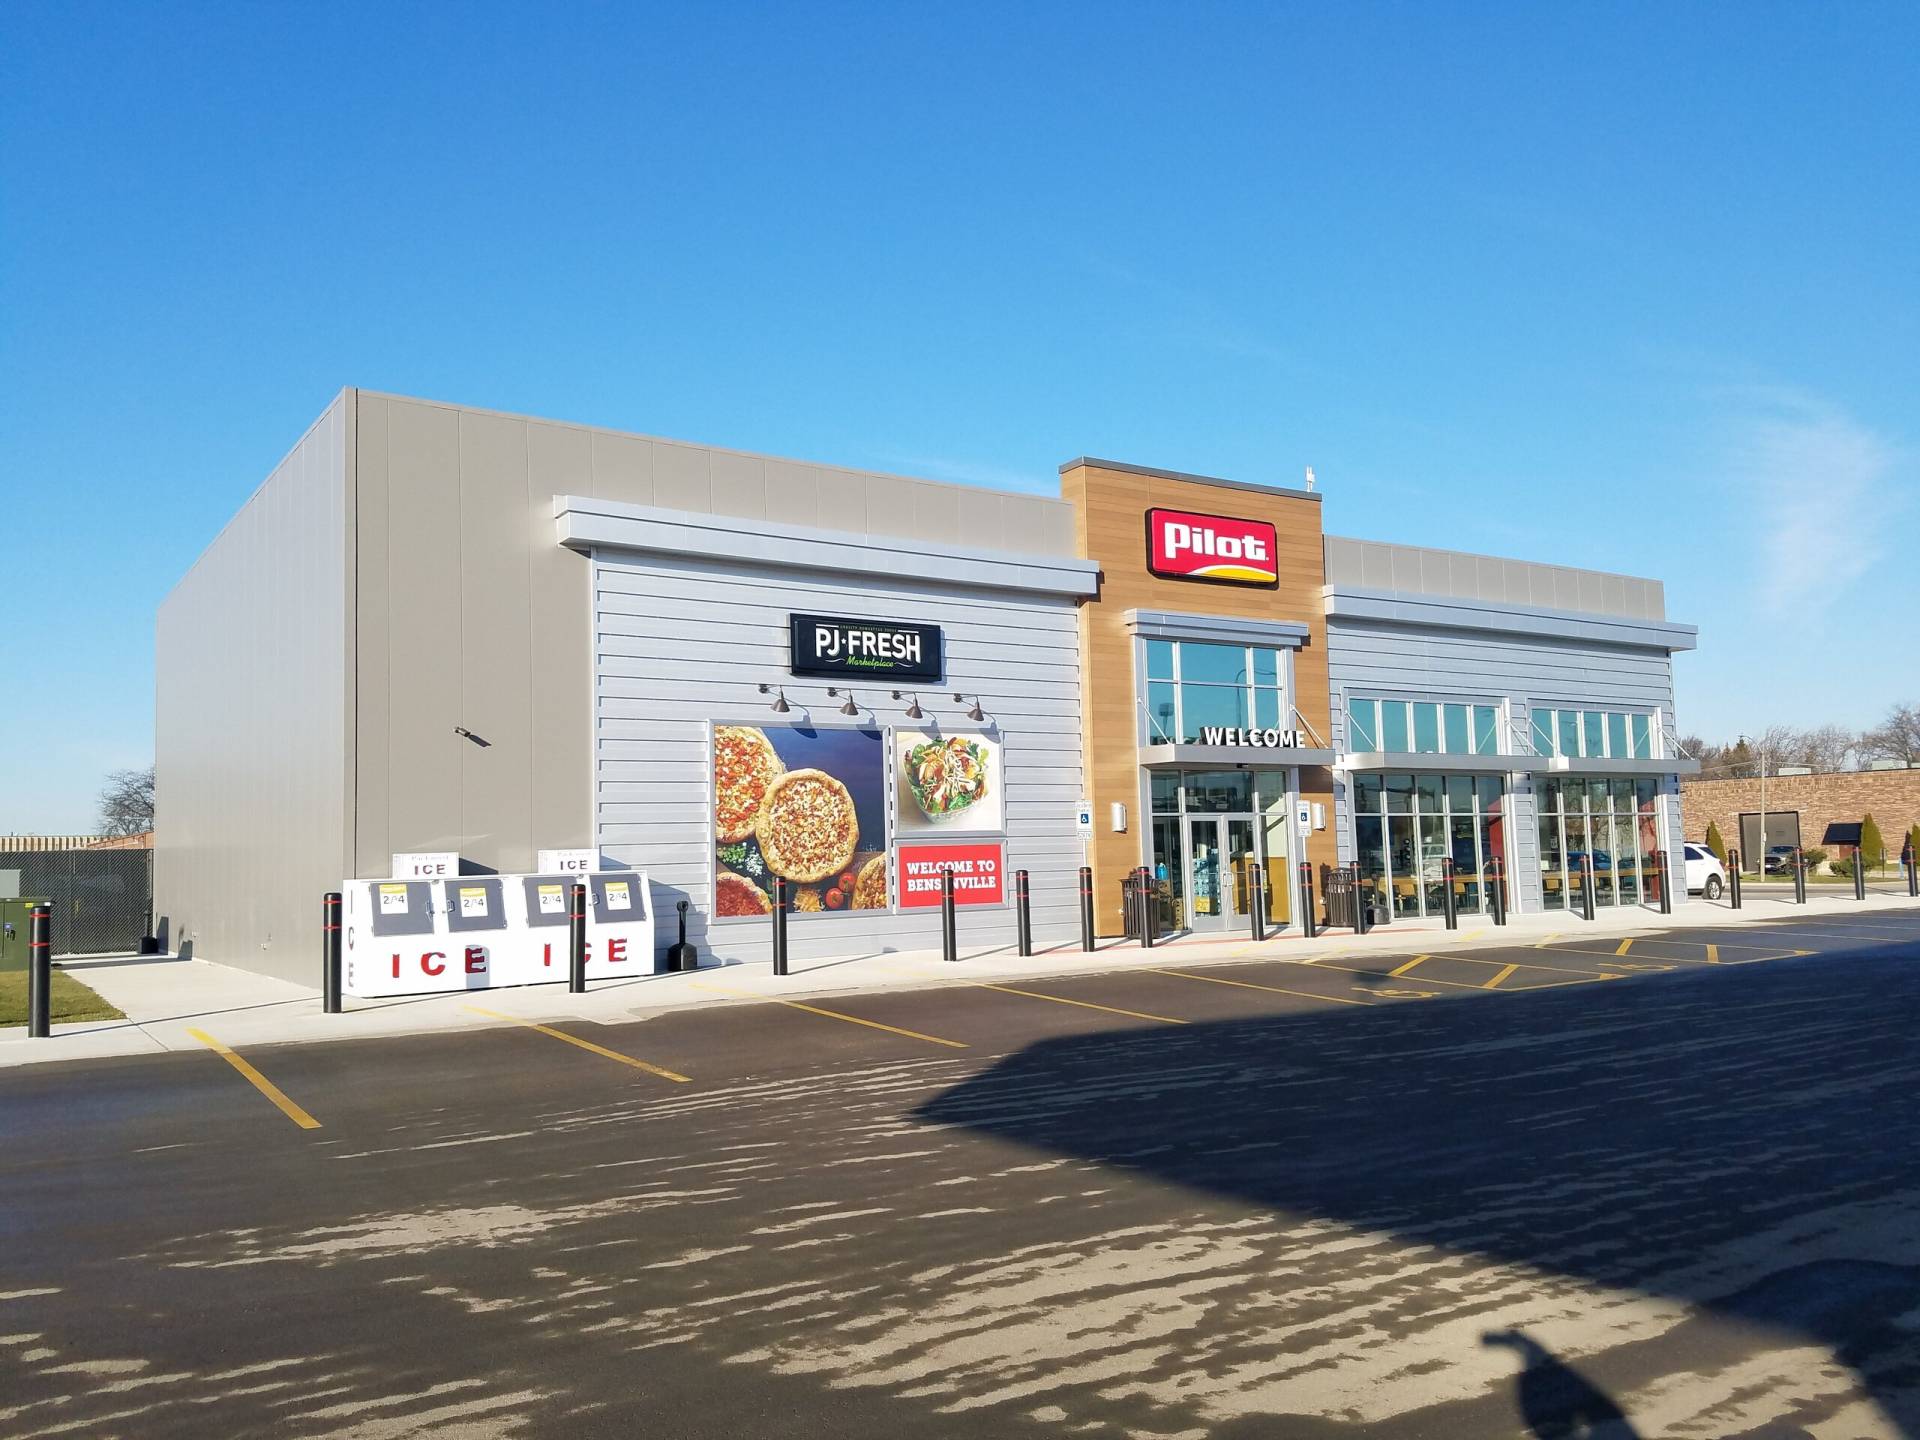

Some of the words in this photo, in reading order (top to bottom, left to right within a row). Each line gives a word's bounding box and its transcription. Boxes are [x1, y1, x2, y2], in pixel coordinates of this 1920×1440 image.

[1164, 522, 1267, 560] Pilot
[847, 630, 921, 663] FRESH
[846, 655, 894, 669] Marketplace
[1202, 726, 1306, 749] WELCOME
[414, 864, 446, 875] ICE
[560, 860, 588, 871] ICE
[907, 861, 974, 875] WELCOME
[977, 860, 996, 872] TO
[907, 876, 997, 892] BENSNVILLE
[544, 938, 628, 967] IE
[392, 947, 487, 979] ICE
